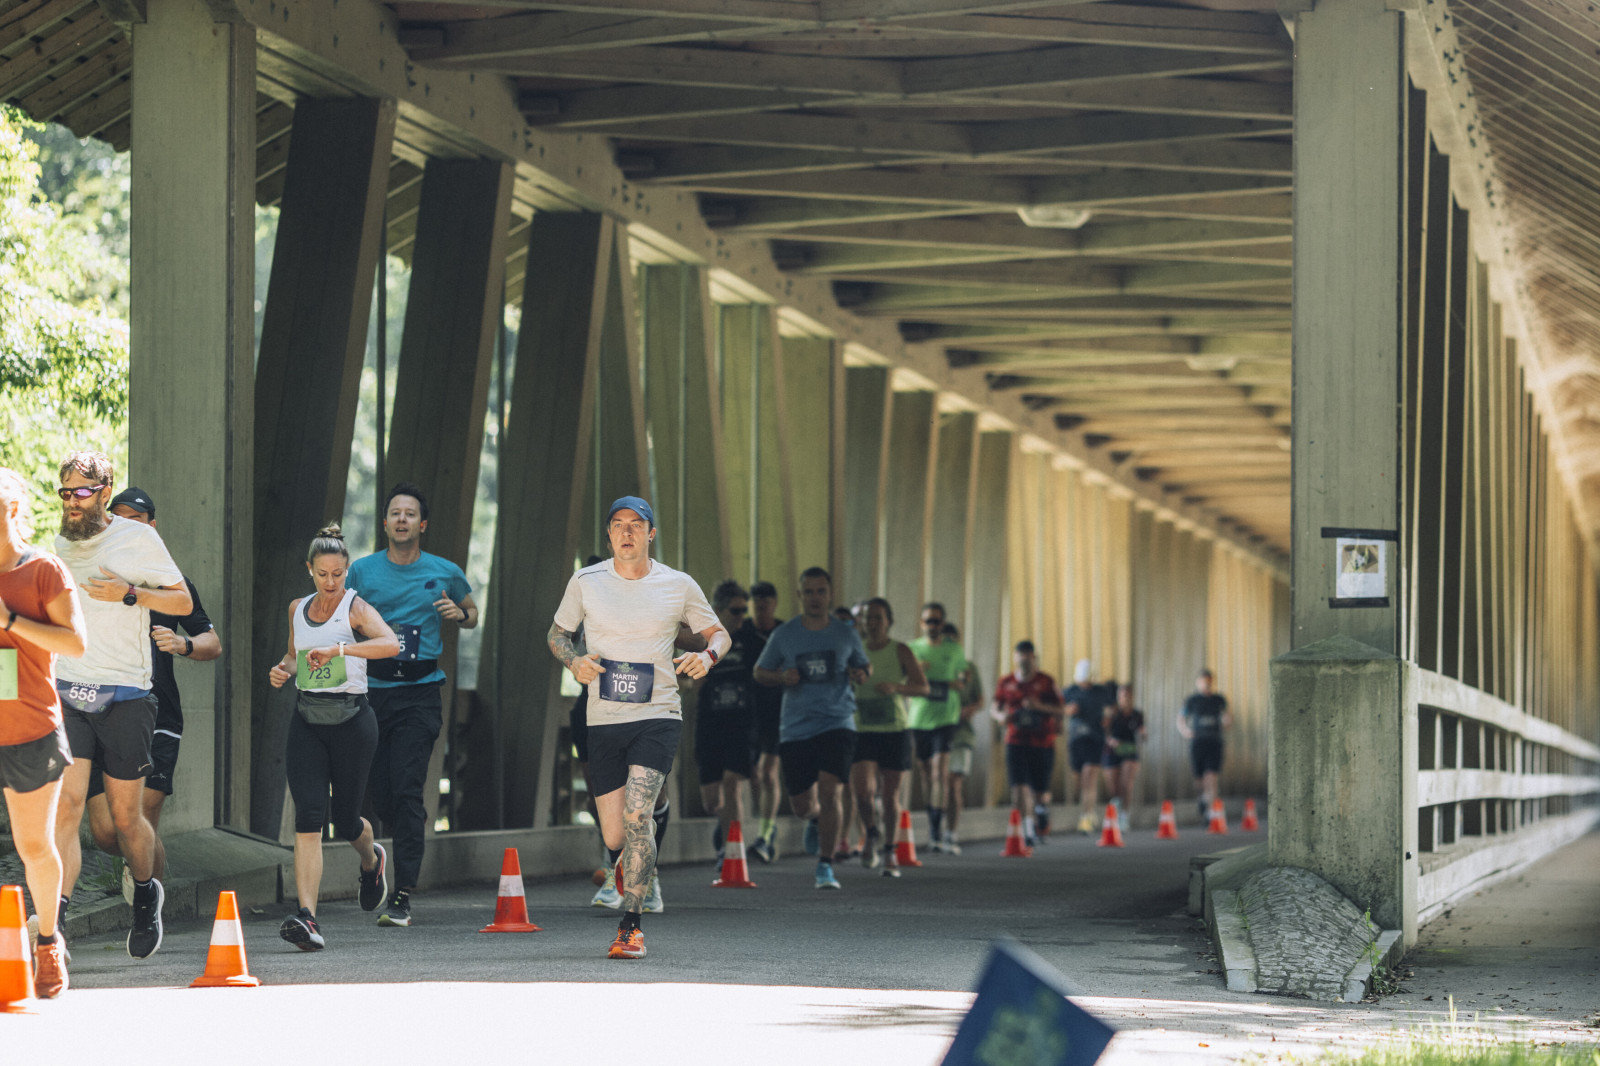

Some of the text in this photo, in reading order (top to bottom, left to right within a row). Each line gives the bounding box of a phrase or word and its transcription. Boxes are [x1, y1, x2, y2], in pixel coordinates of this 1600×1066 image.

[612, 672, 639, 681] MARTIN
[613, 680, 637, 694] 105
[69, 686, 97, 703] 558
